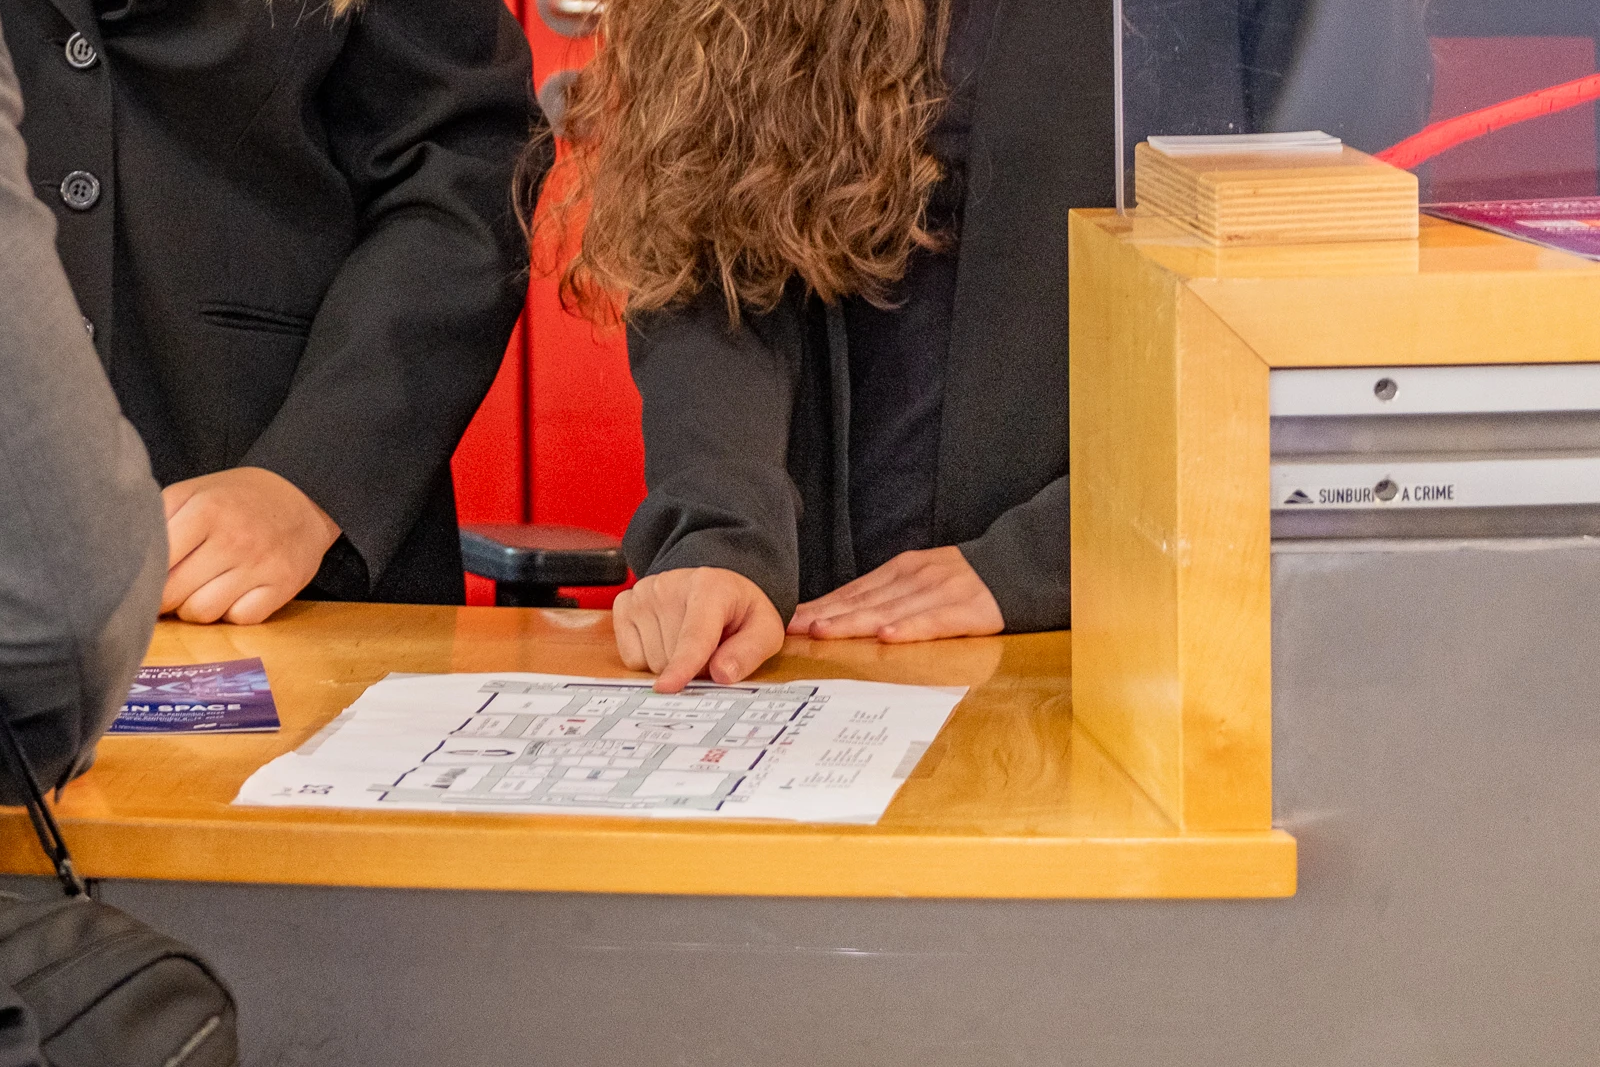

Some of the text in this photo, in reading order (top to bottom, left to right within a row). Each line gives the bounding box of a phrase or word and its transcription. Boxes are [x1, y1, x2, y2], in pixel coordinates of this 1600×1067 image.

[1401, 486, 1410, 502] A
[1414, 484, 1455, 501] CRIME
[157, 703, 241, 712] SPACE
